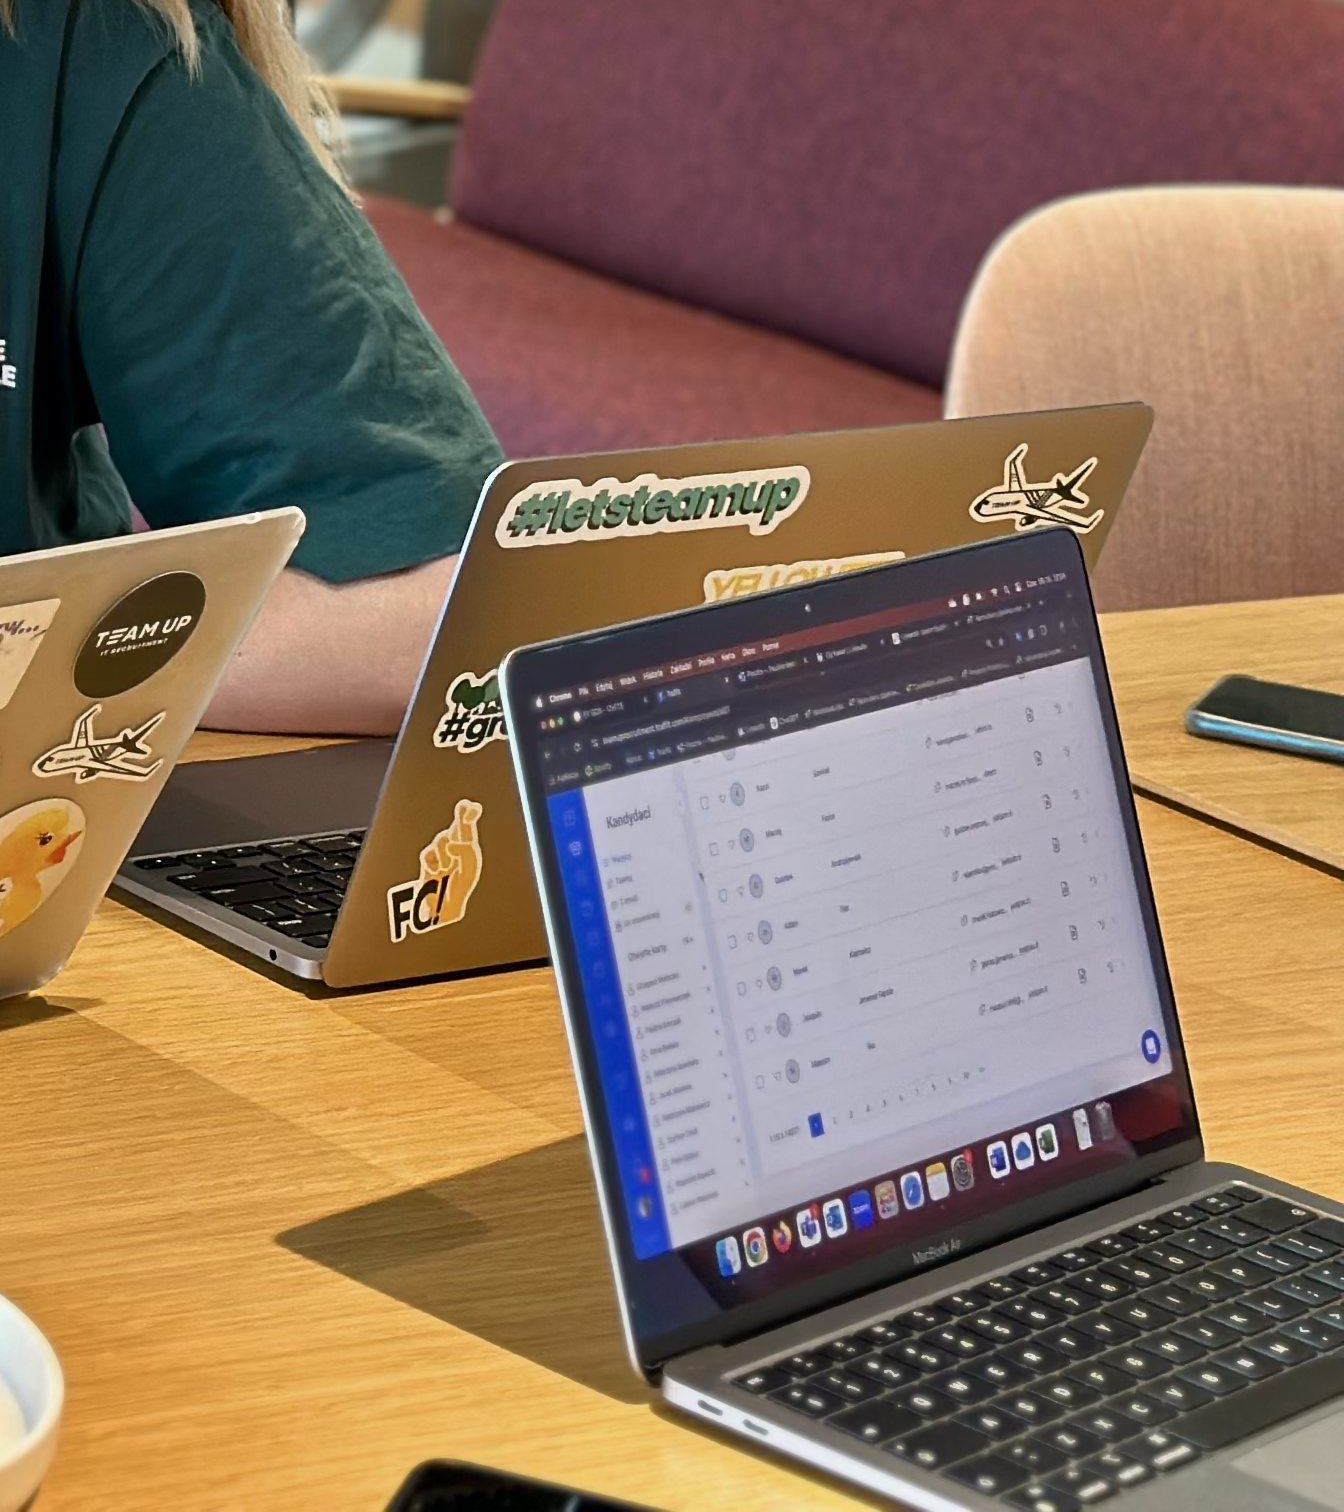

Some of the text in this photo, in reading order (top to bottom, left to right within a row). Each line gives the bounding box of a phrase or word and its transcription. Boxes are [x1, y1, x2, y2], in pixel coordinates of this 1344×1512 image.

[505, 476, 802, 538] #letsteamup
[95, 614, 192, 648] TEAM UP
[605, 804, 652, 829] Kandydaci
[391, 874, 450, 940] FC!
